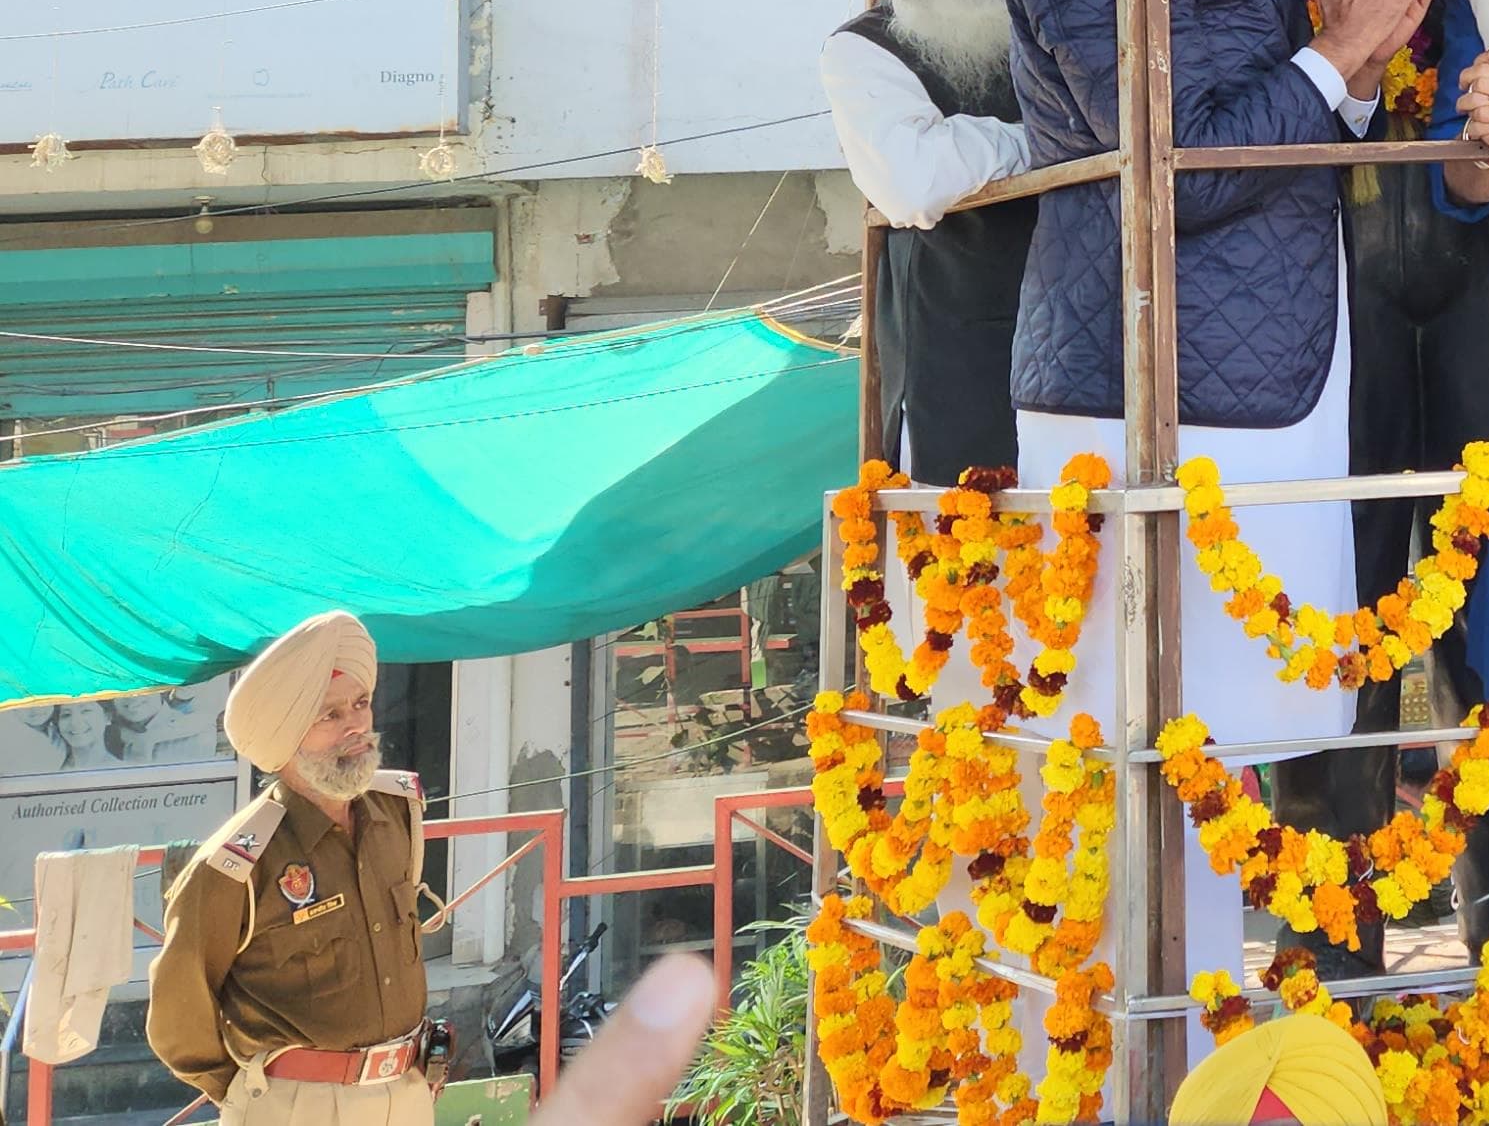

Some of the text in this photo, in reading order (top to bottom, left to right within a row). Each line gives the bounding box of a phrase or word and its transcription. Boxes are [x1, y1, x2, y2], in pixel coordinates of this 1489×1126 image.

[12, 792, 207, 819] Authorised Collection Centre
